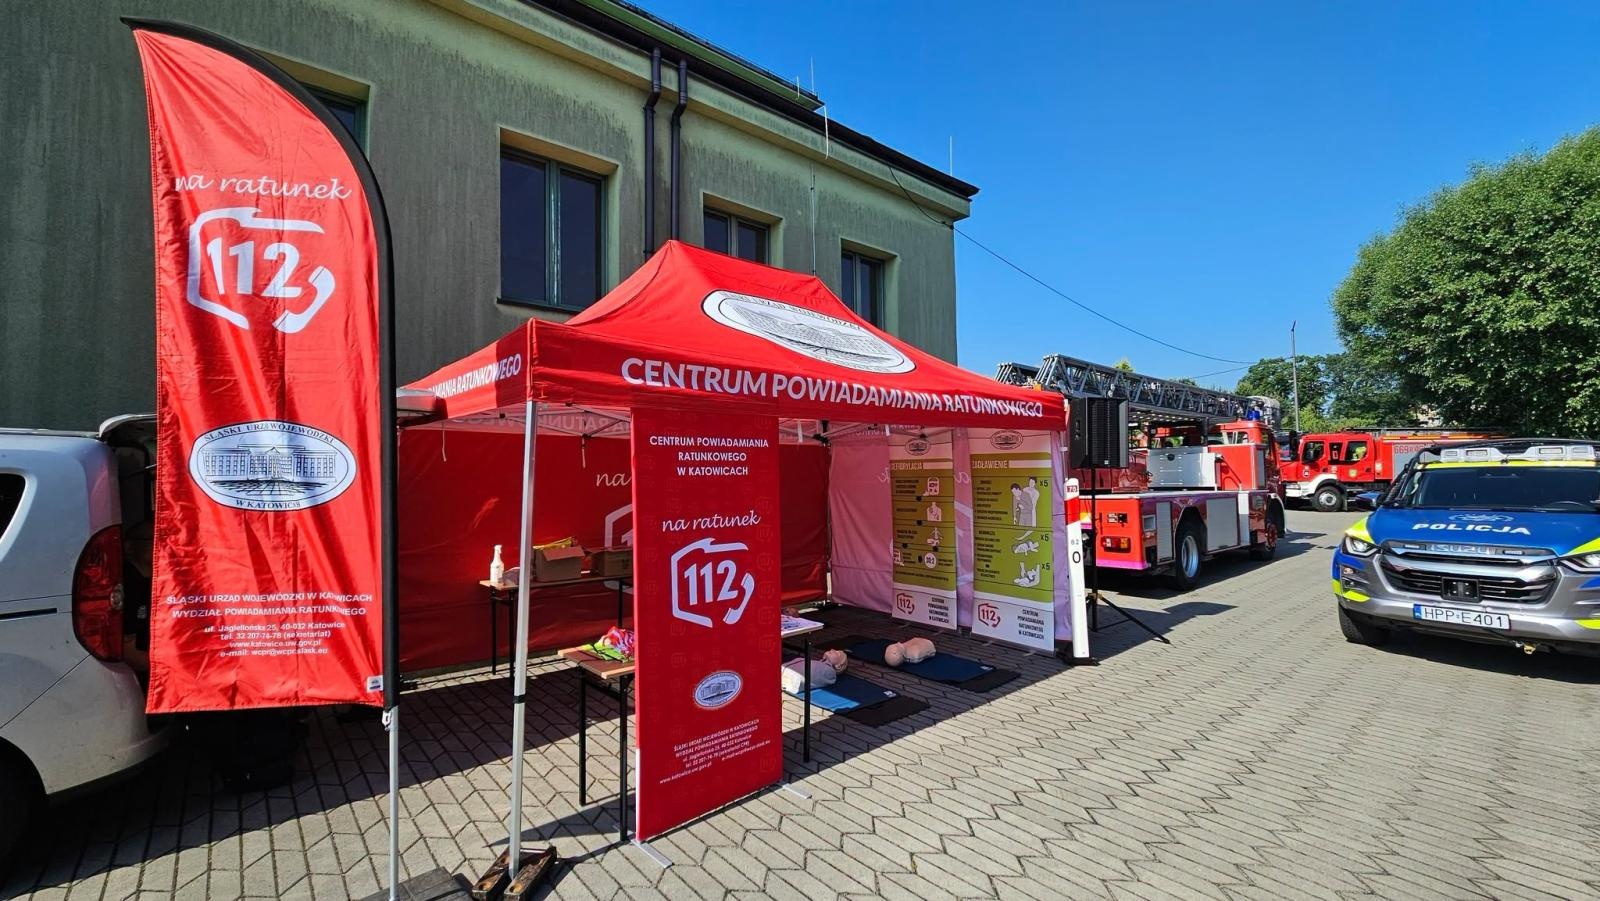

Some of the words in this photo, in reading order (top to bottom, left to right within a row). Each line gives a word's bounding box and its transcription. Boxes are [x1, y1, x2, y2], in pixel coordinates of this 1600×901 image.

[175, 174, 214, 192] na
[219, 178, 352, 200] ratunek
[206, 237, 302, 298] 112
[457, 353, 521, 393] RATUNKOWEGO
[621, 357, 767, 396] CENTRUM
[772, 374, 943, 412] POWIADAMIANIA
[945, 393, 1043, 418] RATUNKOWEGO
[649, 435, 695, 446] CENTRUM
[697, 437, 769, 448] POWIADAMIANIA
[678, 451, 747, 462] RATUNKOWEGO
[677, 467, 686, 476] W
[688, 466, 748, 476] KATOWICACH
[596, 472, 631, 486] na
[662, 519, 690, 532] na
[692, 510, 761, 530] ratunek
[1412, 523, 1531, 535] POLICJA
[684, 559, 739, 606] 112
[209, 594, 241, 603] URZĄD
[307, 592, 317, 600] W
[899, 598, 911, 608] 112
[172, 608, 222, 618] WYDZIAŁ
[225, 606, 295, 616] POWIADAMIANIA
[981, 608, 996, 622] 112
[1424, 607, 1455, 621] HPP
[1461, 611, 1503, 627] E401
